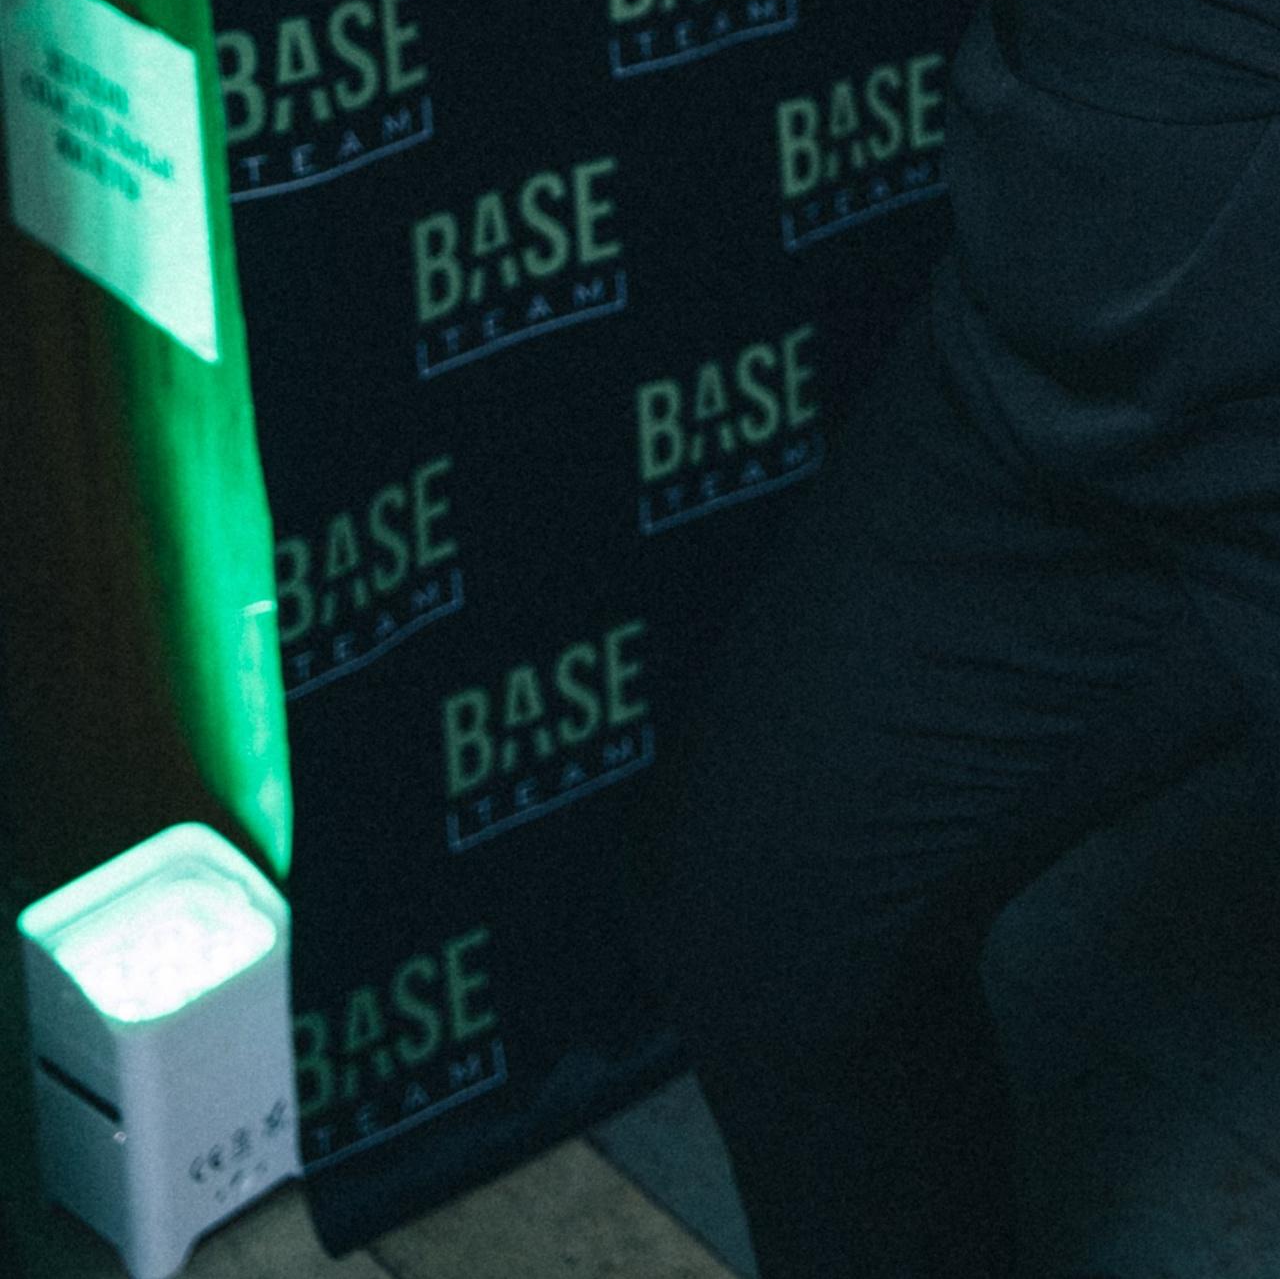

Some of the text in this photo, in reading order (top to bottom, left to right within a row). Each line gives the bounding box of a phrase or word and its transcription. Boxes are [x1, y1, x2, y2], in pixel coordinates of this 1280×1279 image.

[242, 108, 411, 186] TEAM
[776, 50, 945, 200] BASE
[410, 154, 623, 323] BASE
[804, 162, 932, 219] TEAM
[440, 277, 604, 355] TEAM
[635, 321, 820, 484] BASE
[666, 443, 809, 513] TEAM
[275, 453, 459, 643] BASE
[288, 580, 441, 681] TEAM
[443, 618, 651, 798] BASE
[474, 735, 634, 823] TEAM
[294, 925, 499, 1119] BASE
[310, 1053, 481, 1152] TEAM
